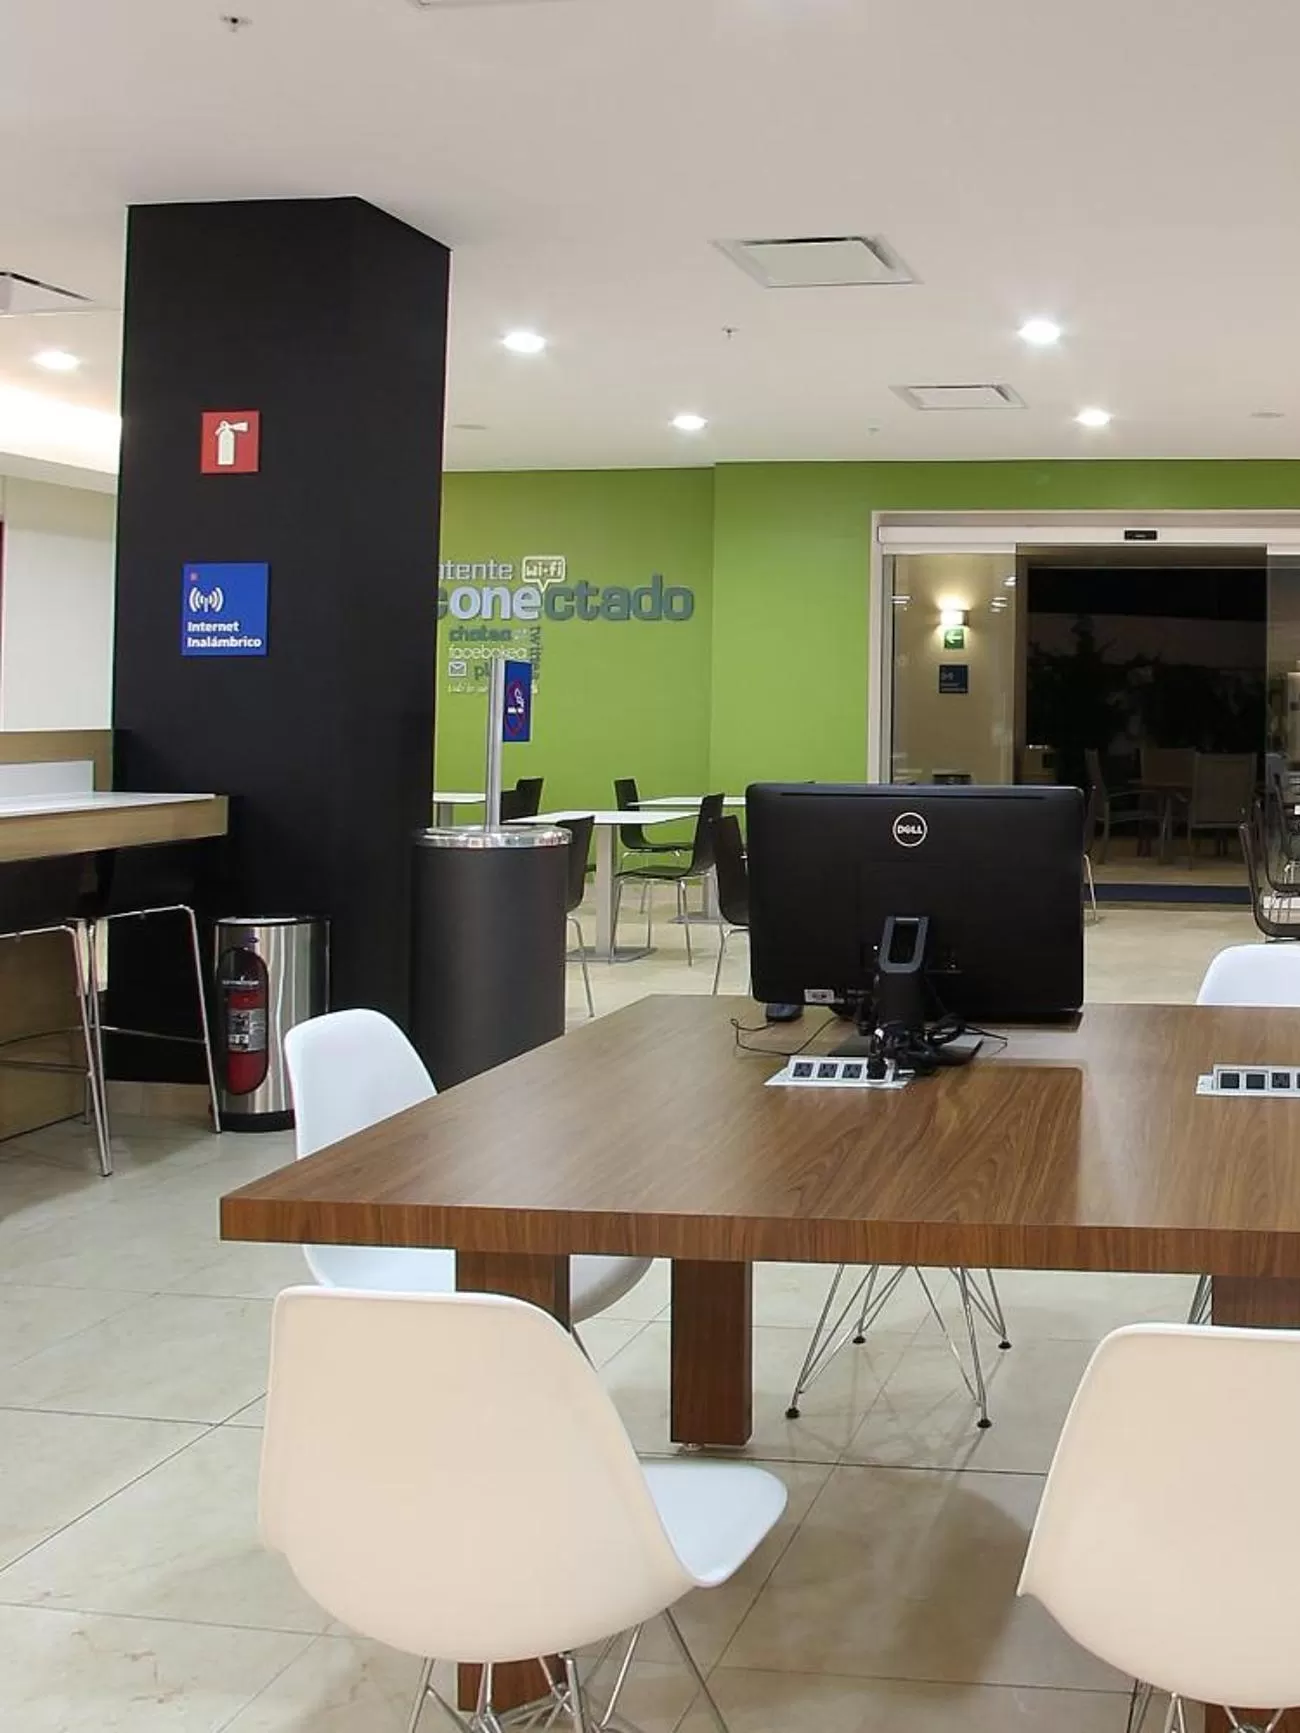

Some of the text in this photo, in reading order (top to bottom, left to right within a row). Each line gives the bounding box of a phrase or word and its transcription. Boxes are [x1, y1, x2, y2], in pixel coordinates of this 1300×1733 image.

[187, 621, 240, 632] Internet
[187, 636, 262, 648] Inalámbrico
[897, 824, 923, 834] DELL
